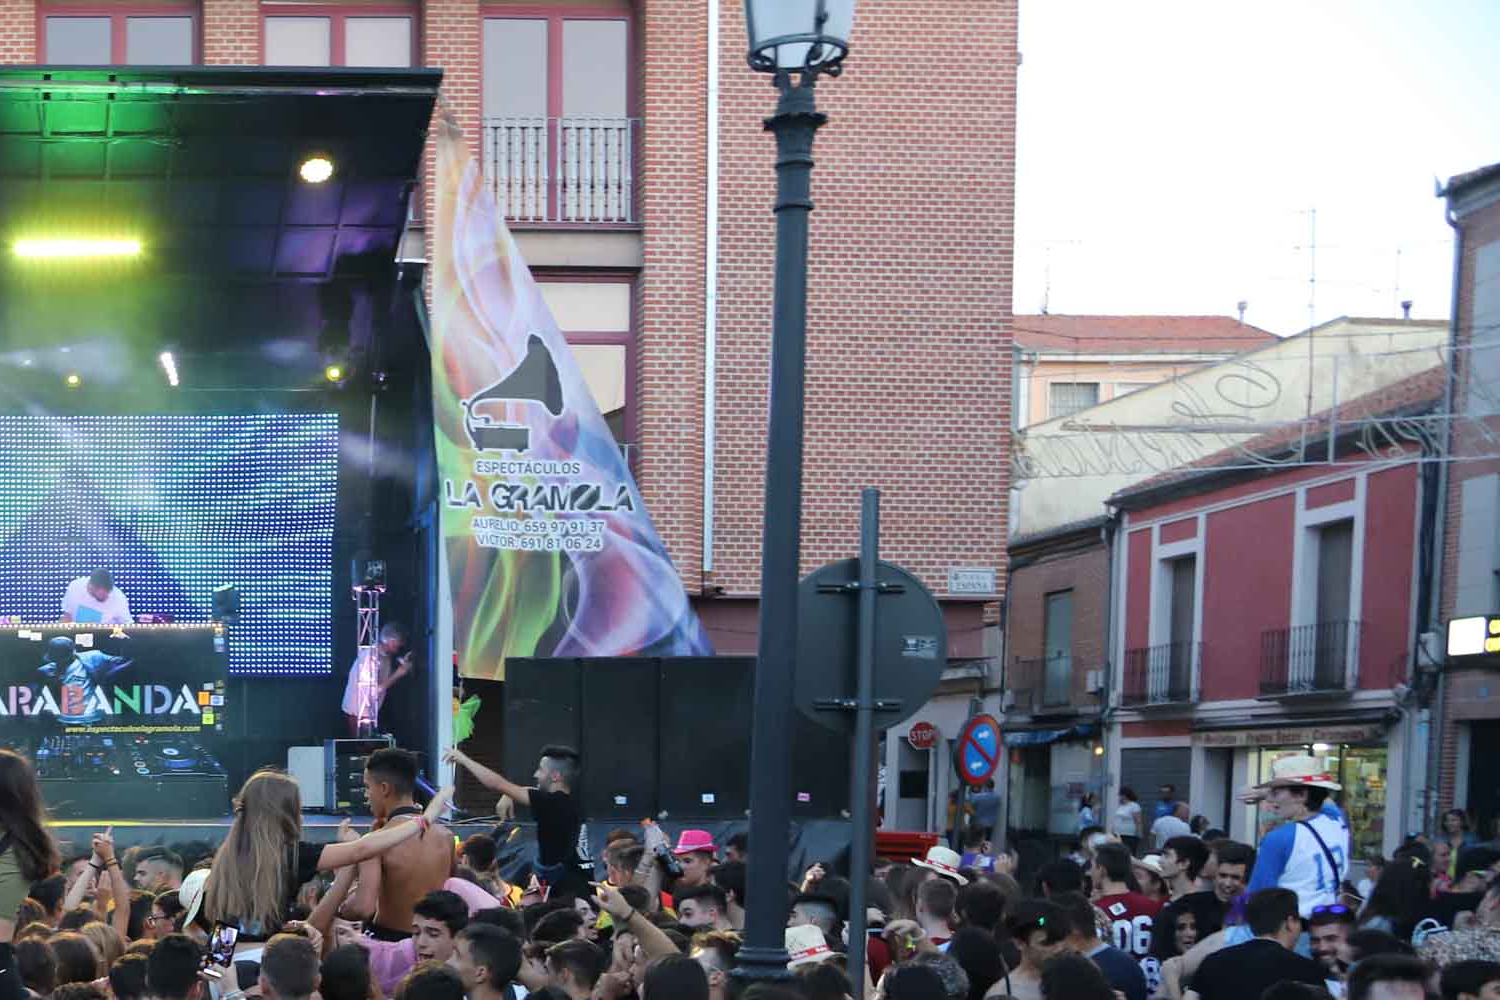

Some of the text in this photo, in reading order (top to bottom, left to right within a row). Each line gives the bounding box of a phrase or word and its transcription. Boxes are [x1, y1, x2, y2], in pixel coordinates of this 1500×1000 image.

[446, 480, 634, 511] LA GRAMOLA
[524, 521, 547, 533] 659
[551, 521, 565, 532] 97
[571, 521, 585, 532] 91
[590, 521, 605, 532] 37
[521, 537, 542, 549] 691
[547, 537, 560, 548] 81
[565, 537, 581, 549] 06
[585, 537, 600, 549] 24
